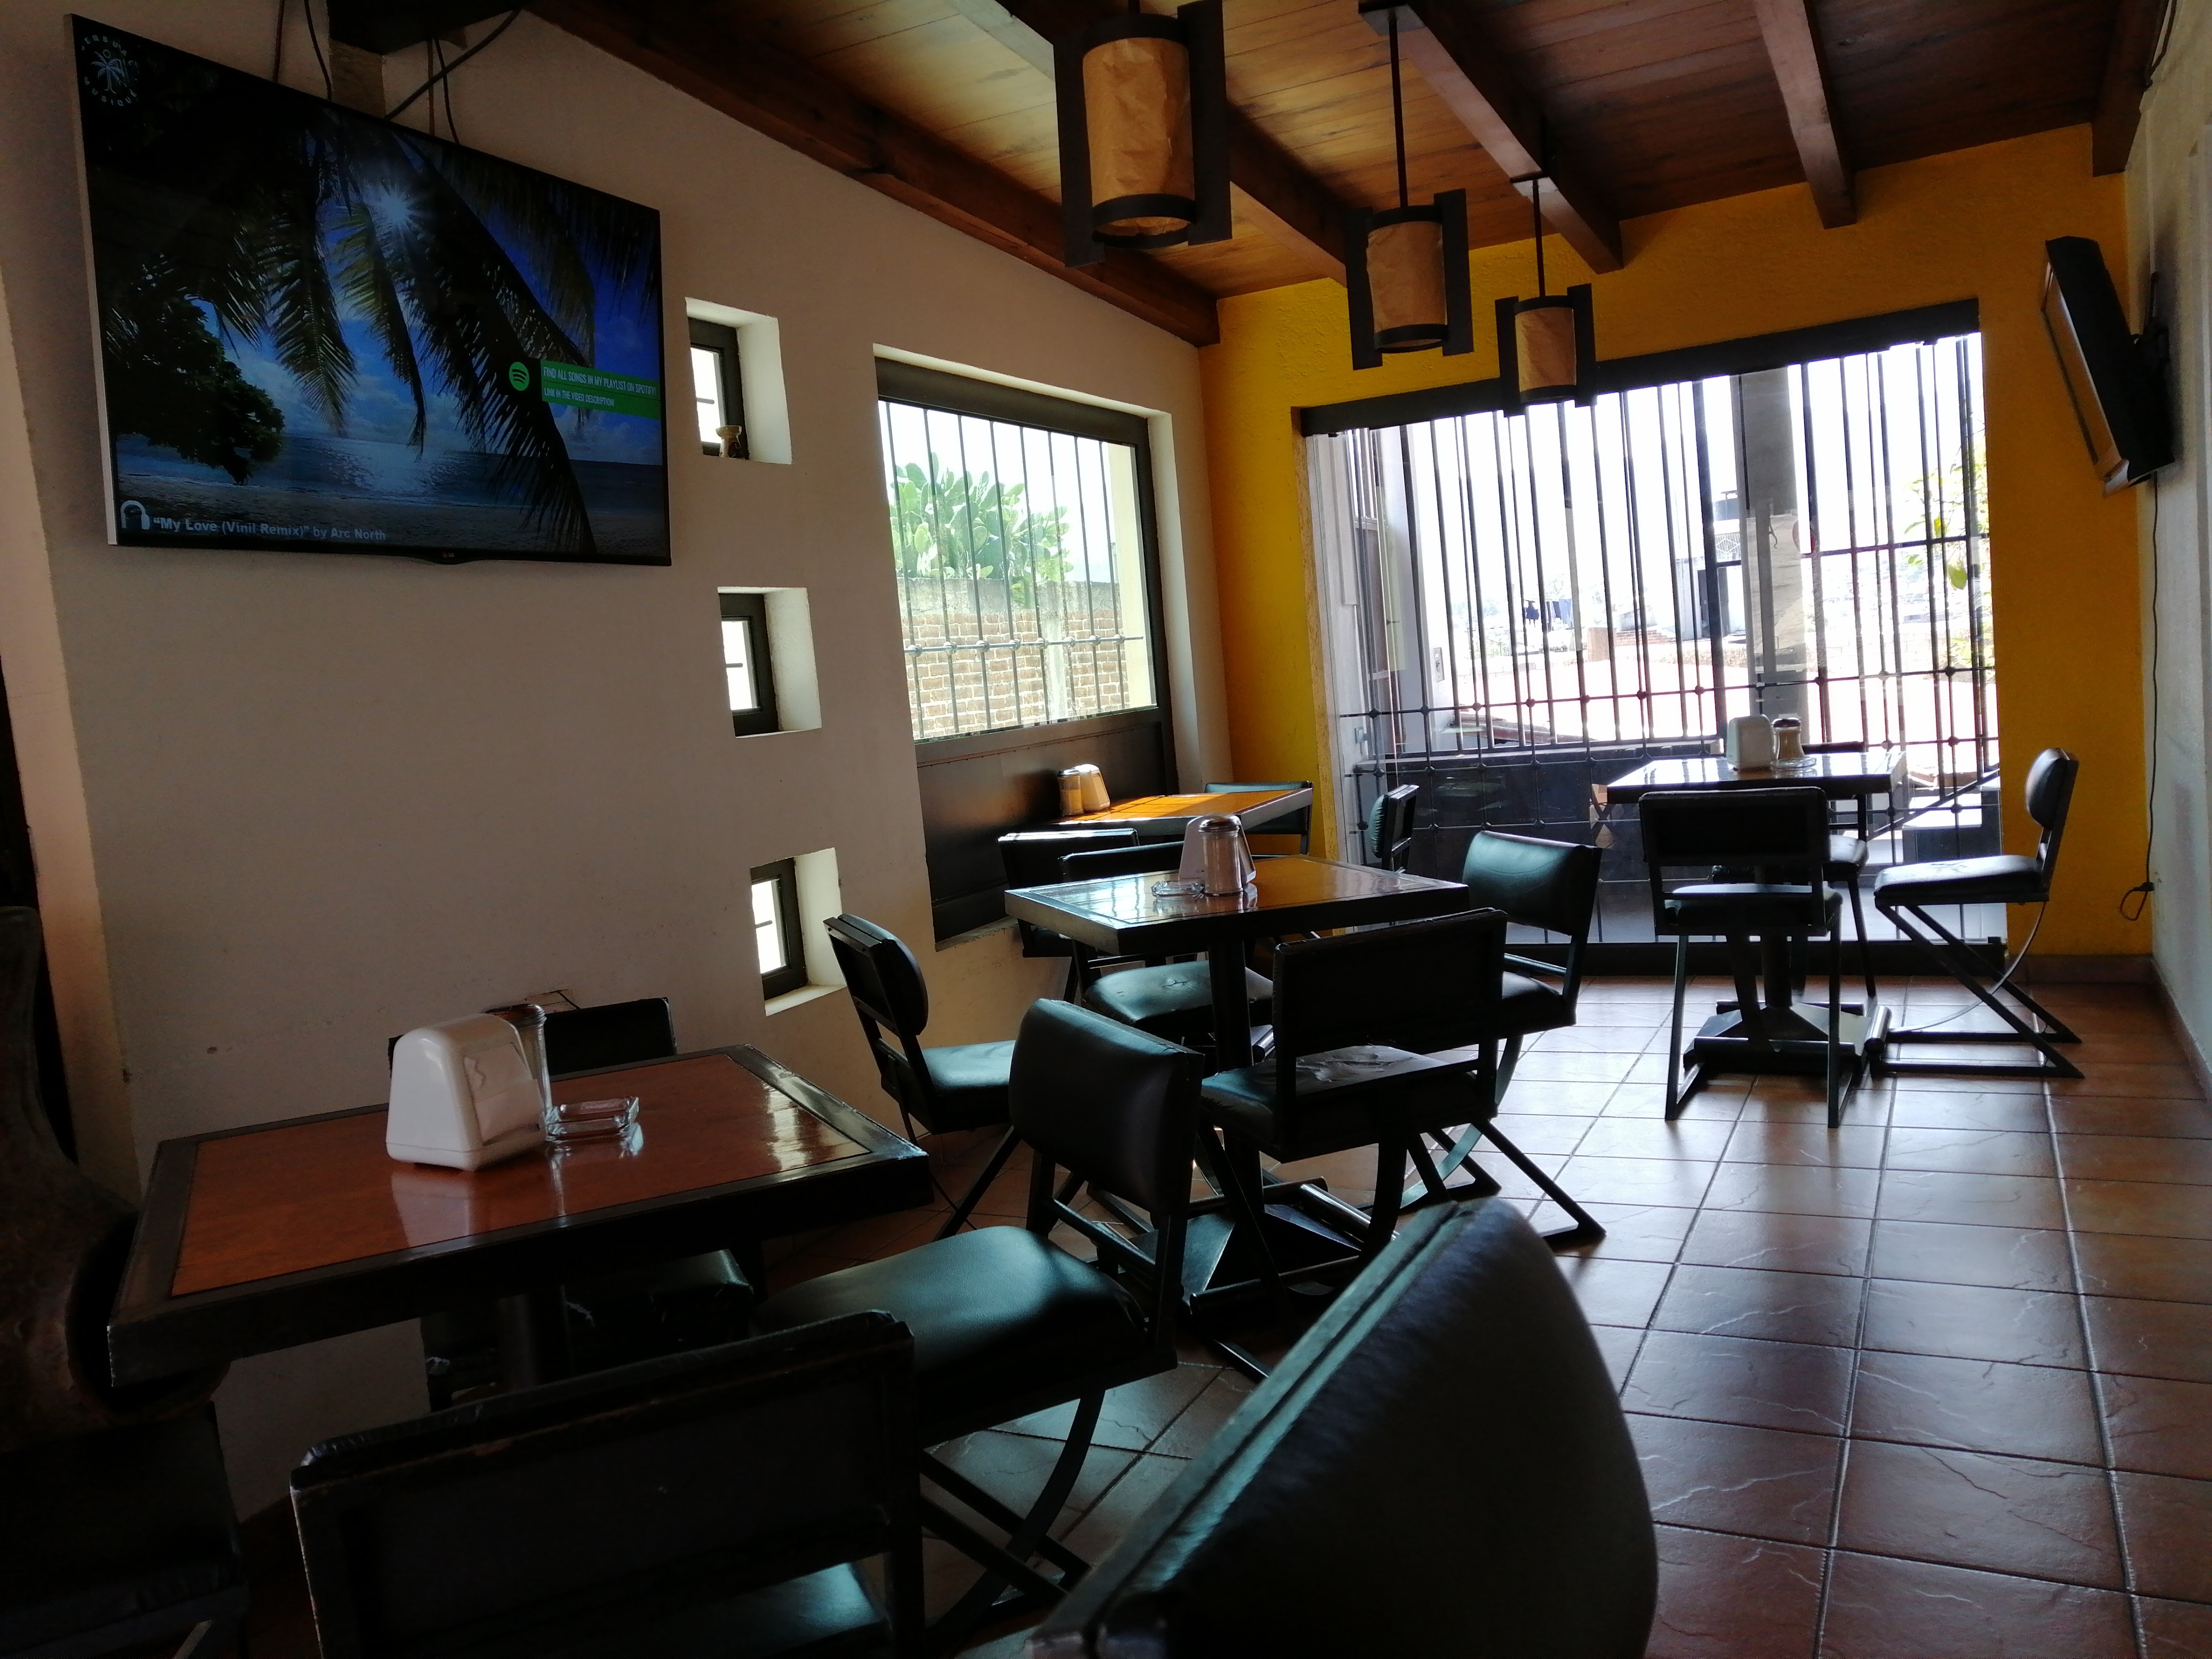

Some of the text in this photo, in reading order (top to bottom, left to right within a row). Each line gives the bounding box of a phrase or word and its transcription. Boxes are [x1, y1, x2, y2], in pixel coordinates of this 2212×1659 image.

[543, 367, 656, 396] FIND ALL SONGS IN MY PLAYLIST ON SPOTIFY!
[544, 388, 556, 397] LINK
[556, 389, 561, 398] IN
[562, 390, 571, 400] THE
[572, 392, 585, 402] VIDEO
[185, 519, 218, 532] Love
[222, 521, 256, 535] (Vinil
[313, 526, 326, 540] by
[331, 528, 350, 539] Arc
[354, 529, 386, 541] North
